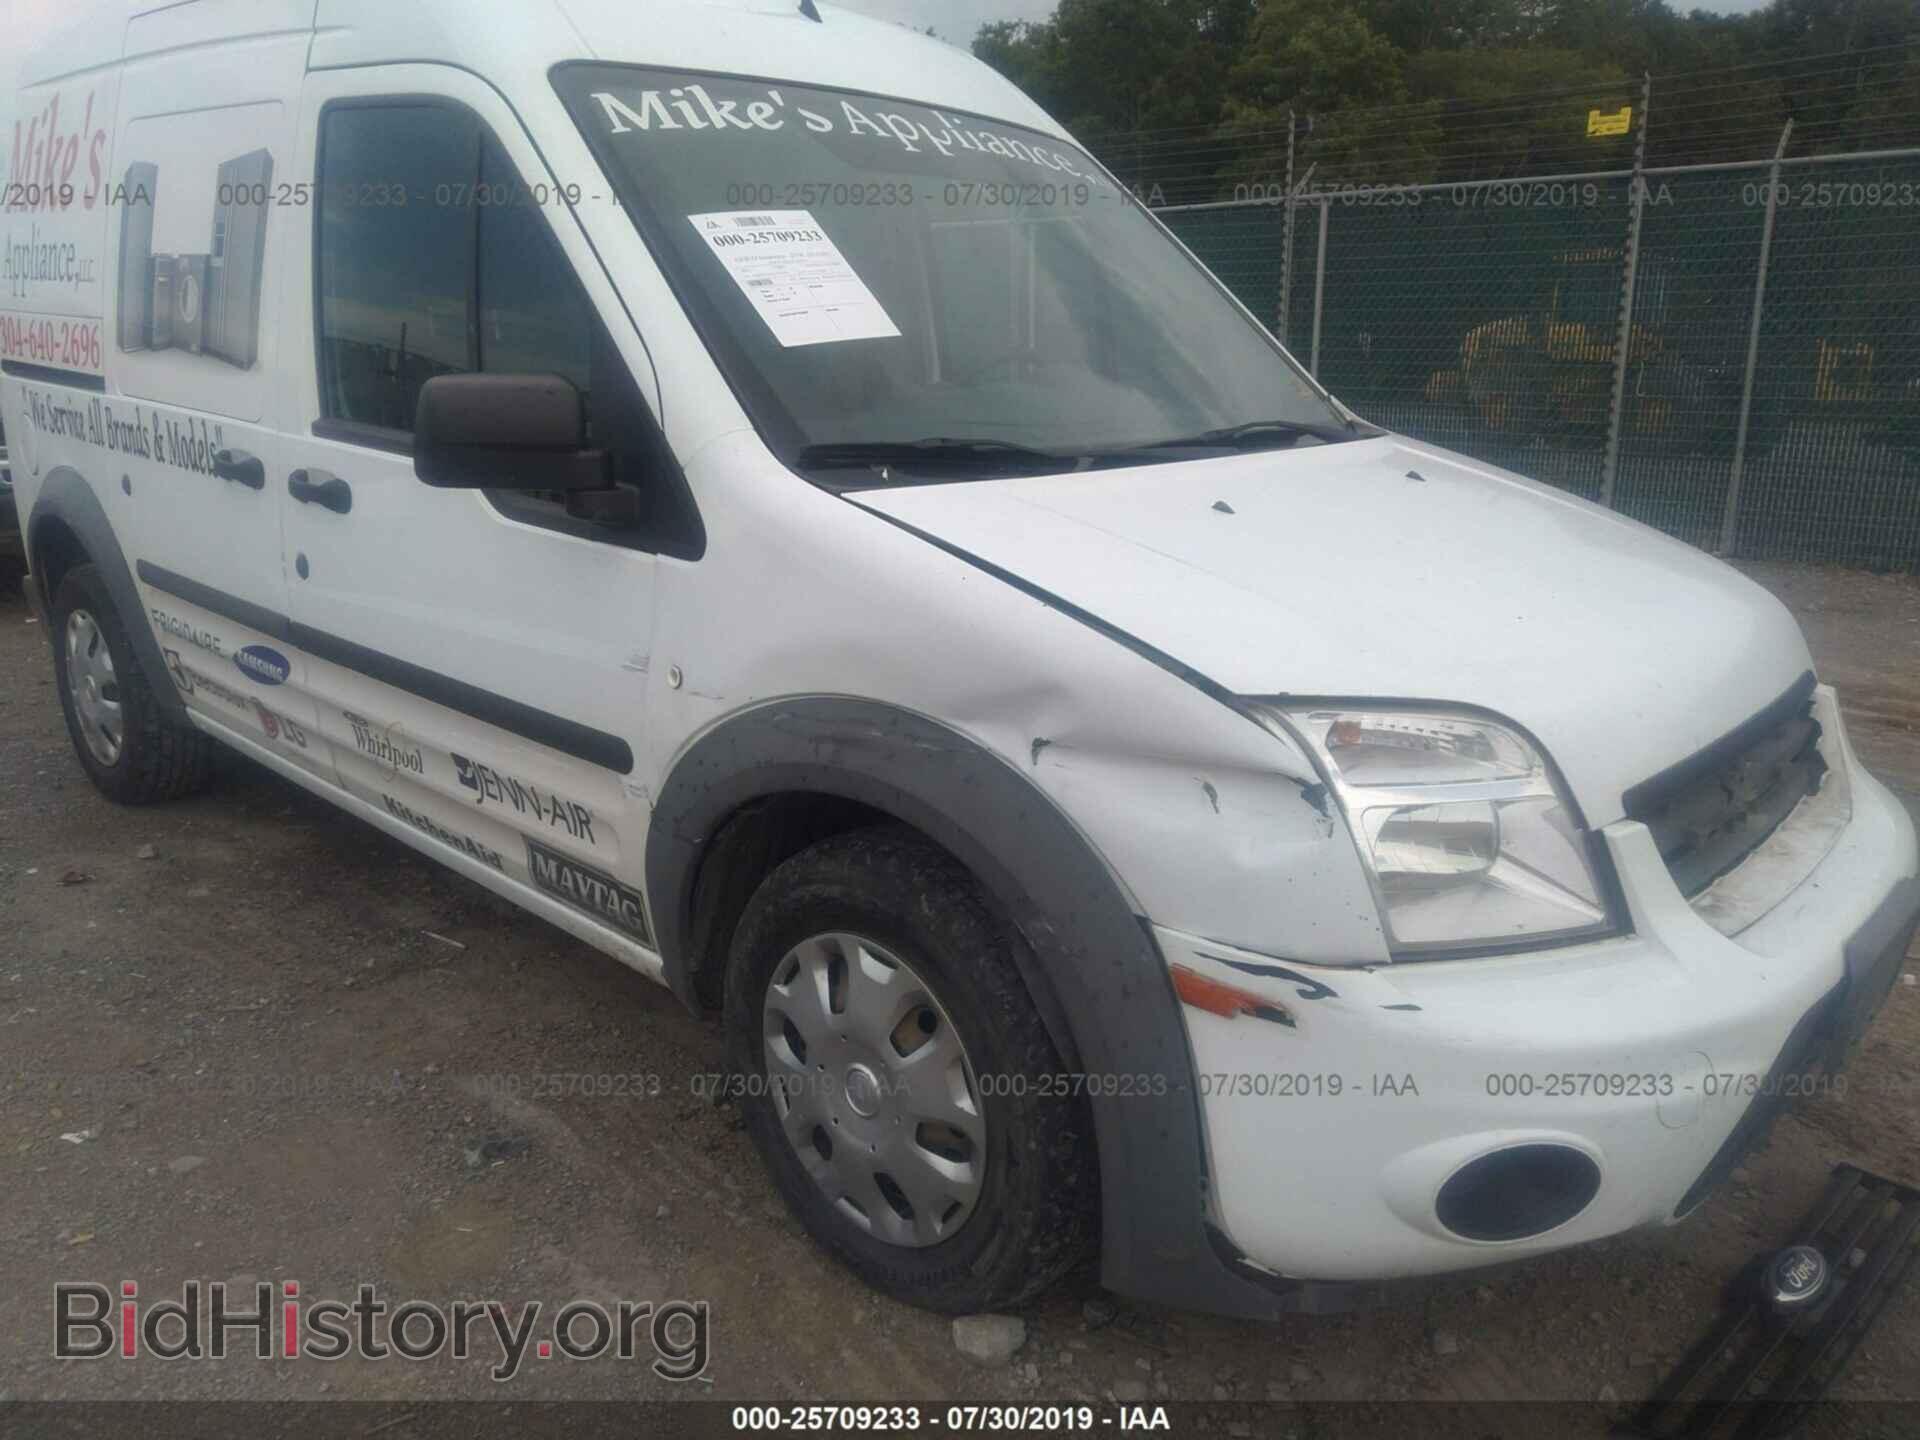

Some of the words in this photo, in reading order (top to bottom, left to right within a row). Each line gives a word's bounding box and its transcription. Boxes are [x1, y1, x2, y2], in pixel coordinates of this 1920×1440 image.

[592, 84, 834, 134] Mike's
[4, 89, 107, 213] Mike's
[713, 230, 823, 248] 000-25709233
[0, 315, 100, 368] 304-640-2696
[46, 393, 86, 442] Service
[87, 396, 105, 446] All
[105, 404, 151, 460] Brands
[152, 411, 166, 464] &
[151, 608, 221, 653] FRIGIDAIRE
[351, 723, 424, 775] Whirlpool
[473, 761, 596, 844] JENN-AIR
[533, 850, 643, 931] MAYTAG
